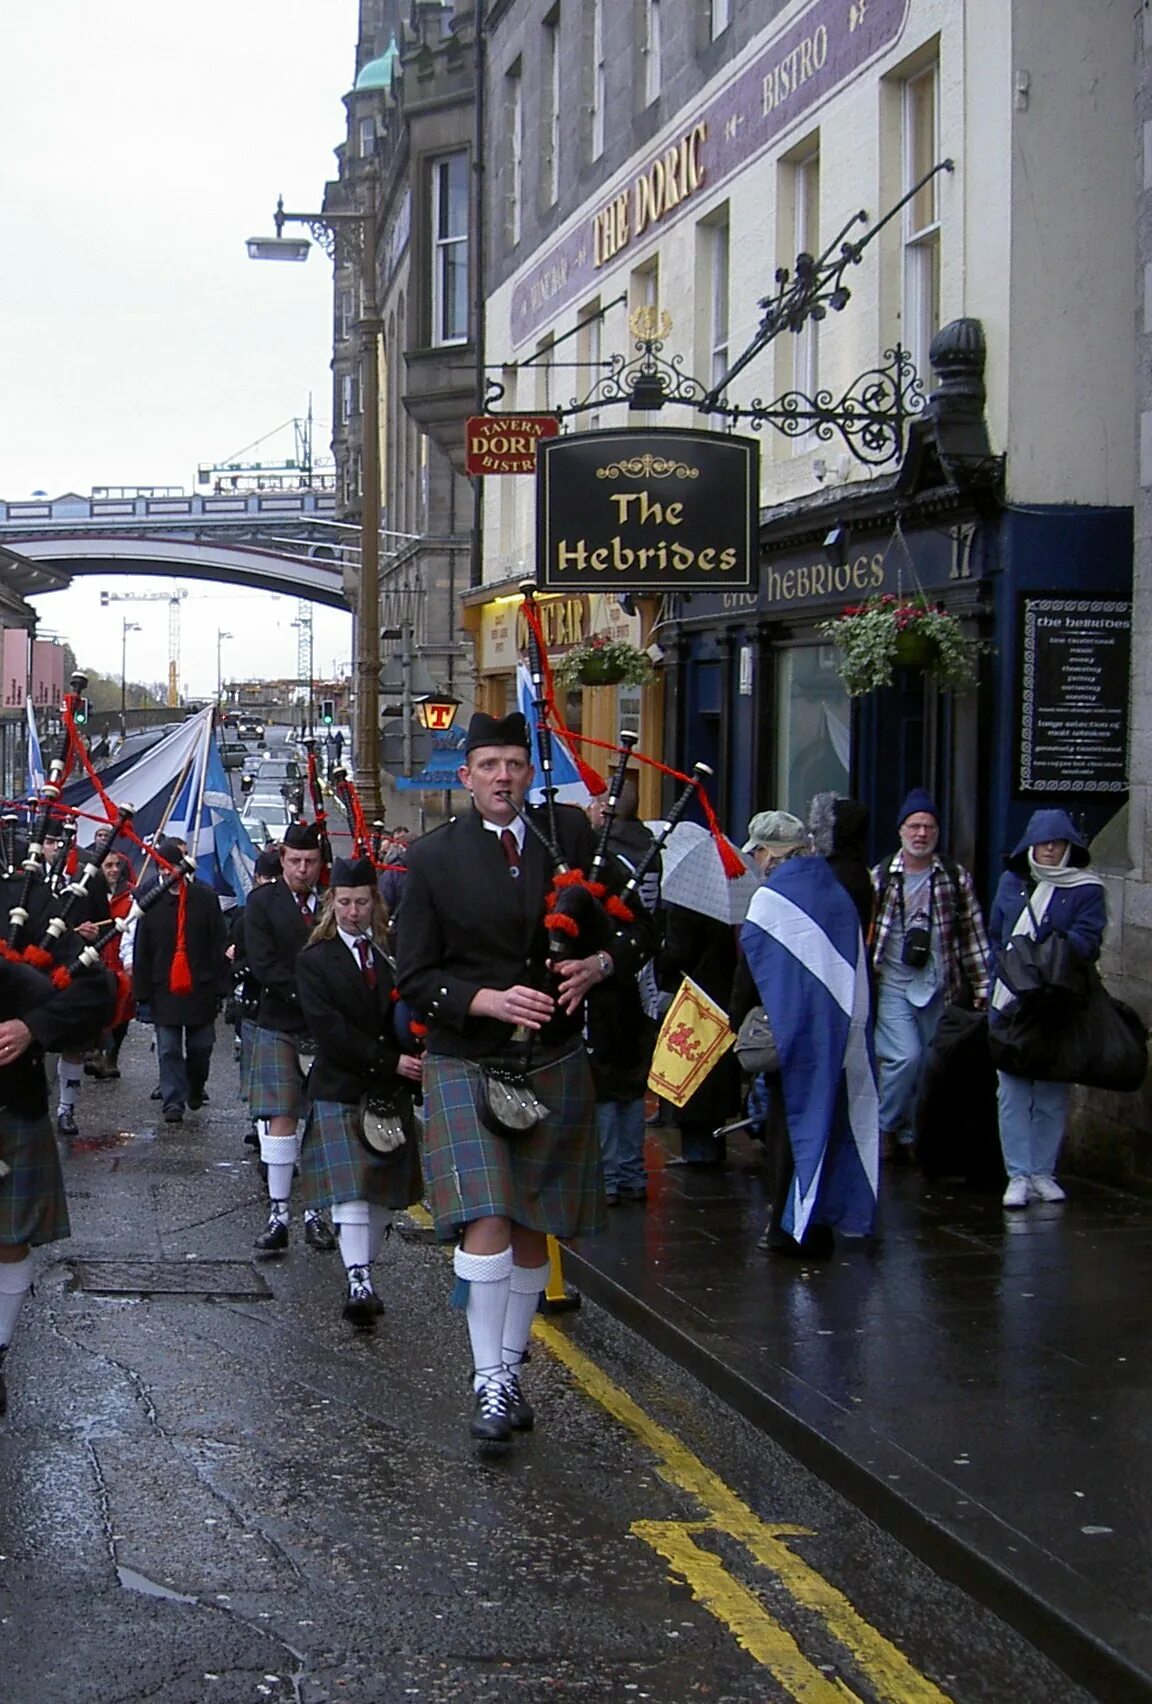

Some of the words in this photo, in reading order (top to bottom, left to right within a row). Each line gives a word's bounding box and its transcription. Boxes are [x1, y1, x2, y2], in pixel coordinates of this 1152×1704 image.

[593, 188, 631, 268] THE
[634, 120, 707, 237] DORIC
[762, 24, 827, 117] BISTRO
[472, 436, 537, 454] DORI
[480, 420, 544, 436] TAVERN
[609, 490, 684, 526] The
[557, 536, 737, 572] Hebrides
[949, 522, 977, 578] 17
[556, 599, 584, 646] BAR
[1037, 617, 1062, 627] the
[431, 706, 450, 727] T
